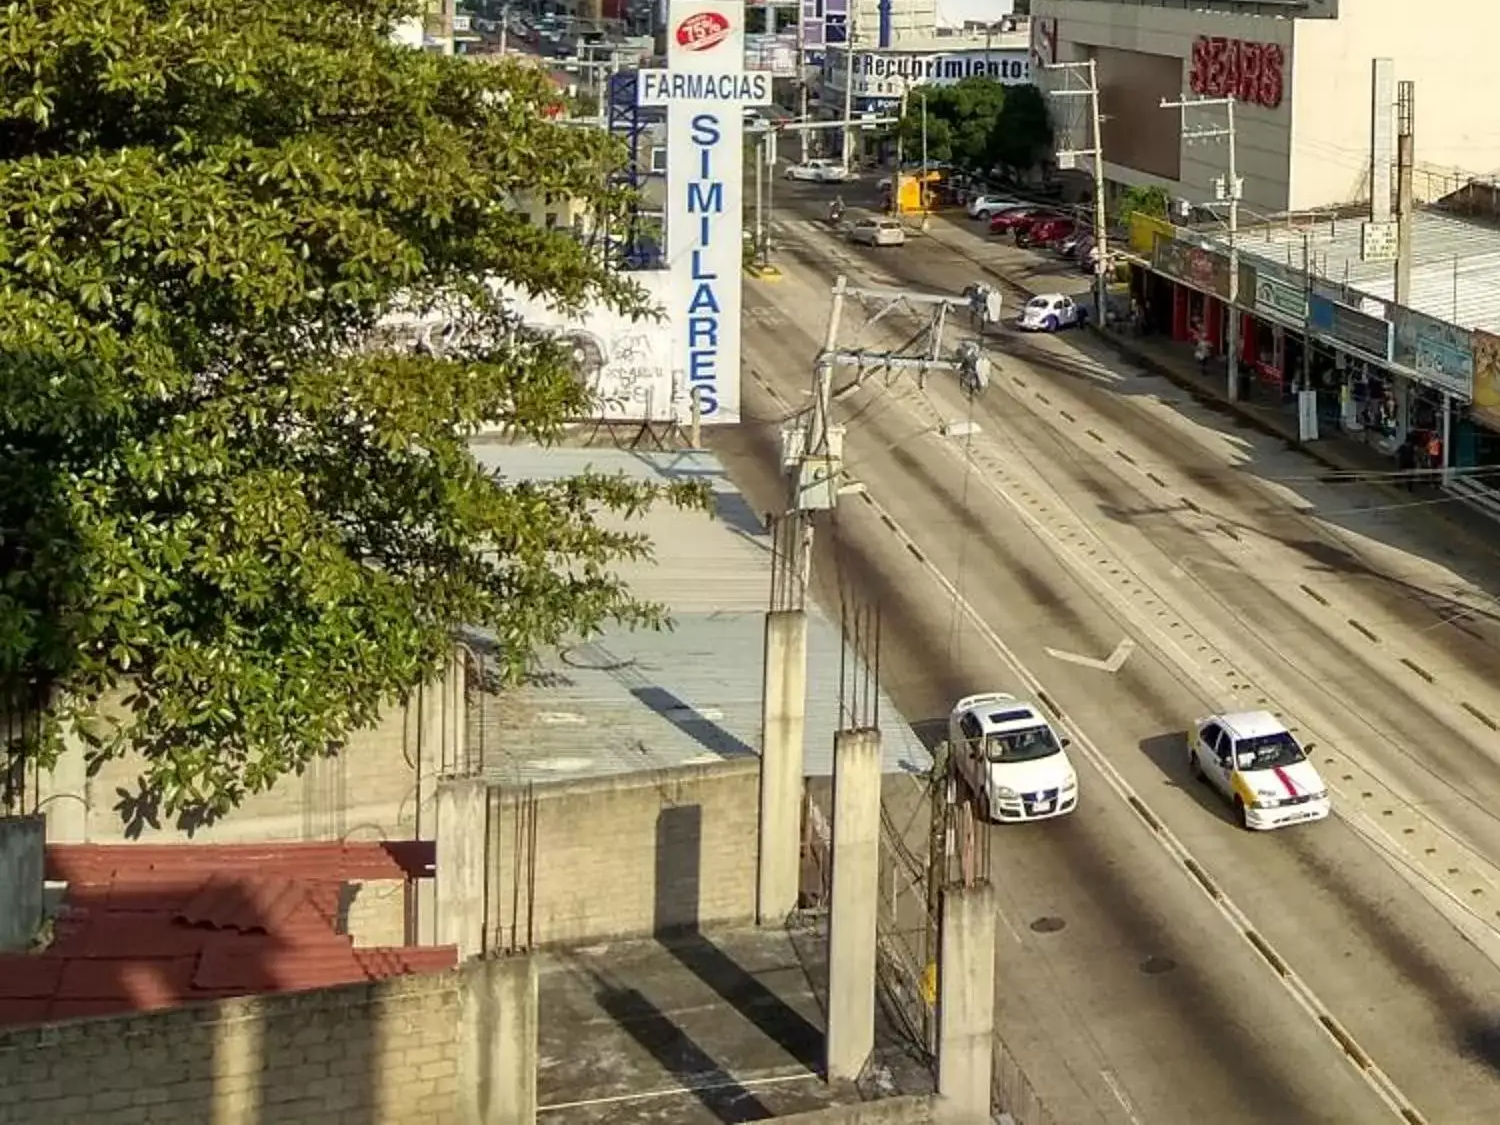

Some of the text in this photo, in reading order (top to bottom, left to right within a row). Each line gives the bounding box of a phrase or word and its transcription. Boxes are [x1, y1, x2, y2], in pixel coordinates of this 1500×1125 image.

[683, 17, 722, 43] 75%
[645, 74, 766, 100] FARMACIAS
[687, 114, 723, 416] SIMILARES
